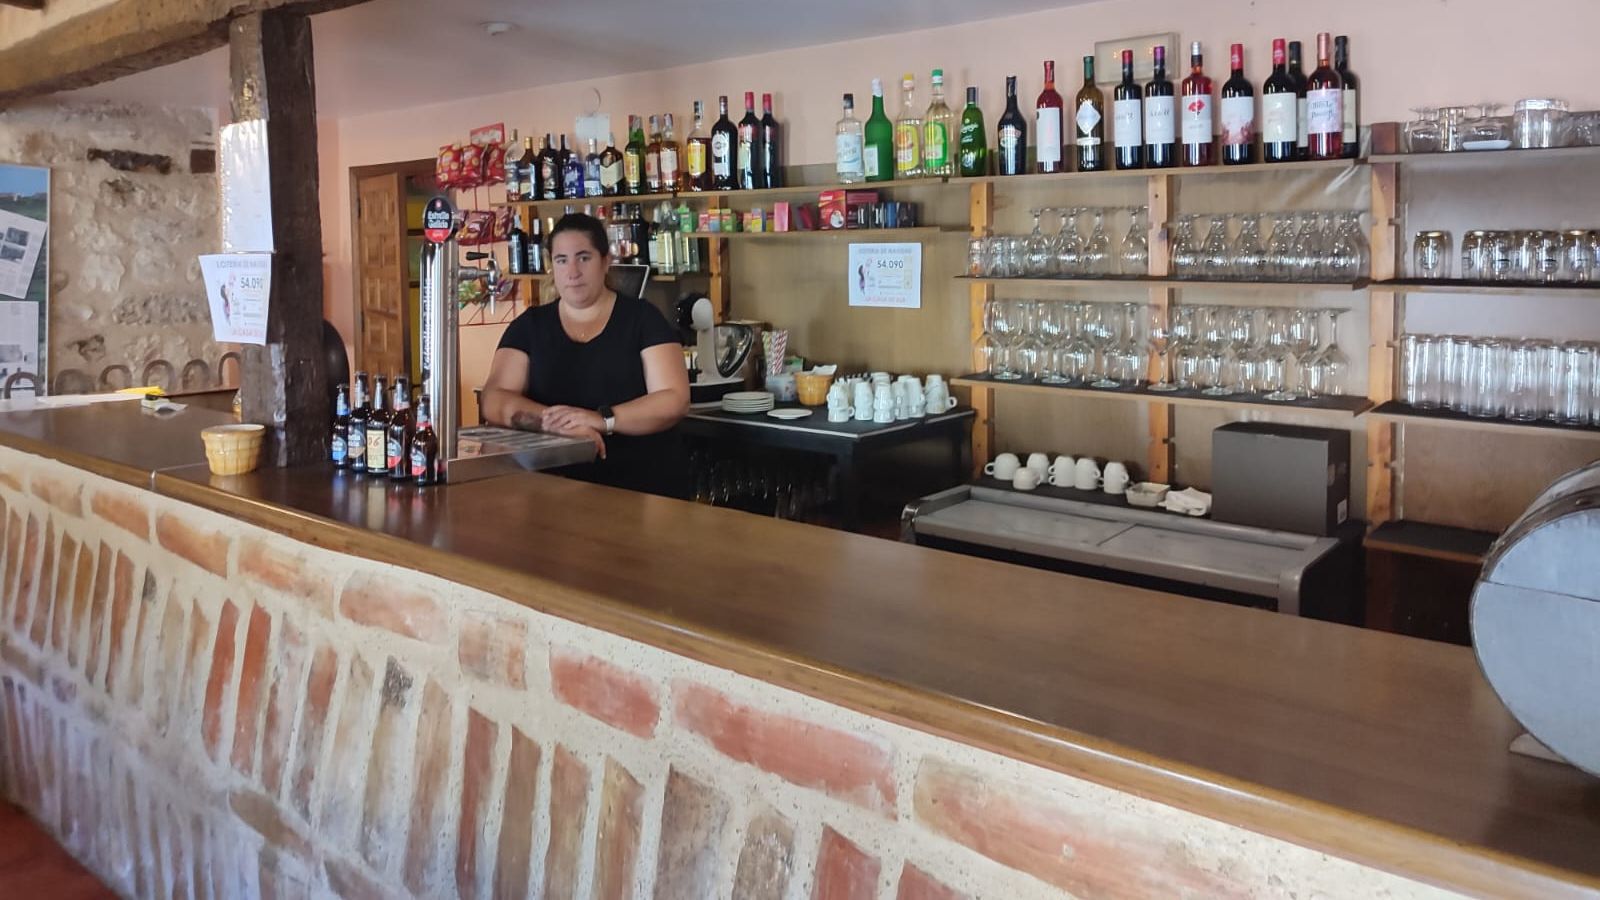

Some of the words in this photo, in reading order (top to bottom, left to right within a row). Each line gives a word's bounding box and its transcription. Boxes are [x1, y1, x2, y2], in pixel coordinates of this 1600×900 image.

[428, 211, 450, 220] Estrella
[428, 220, 449, 229] Galicia
[877, 260, 904, 269] 54.090
